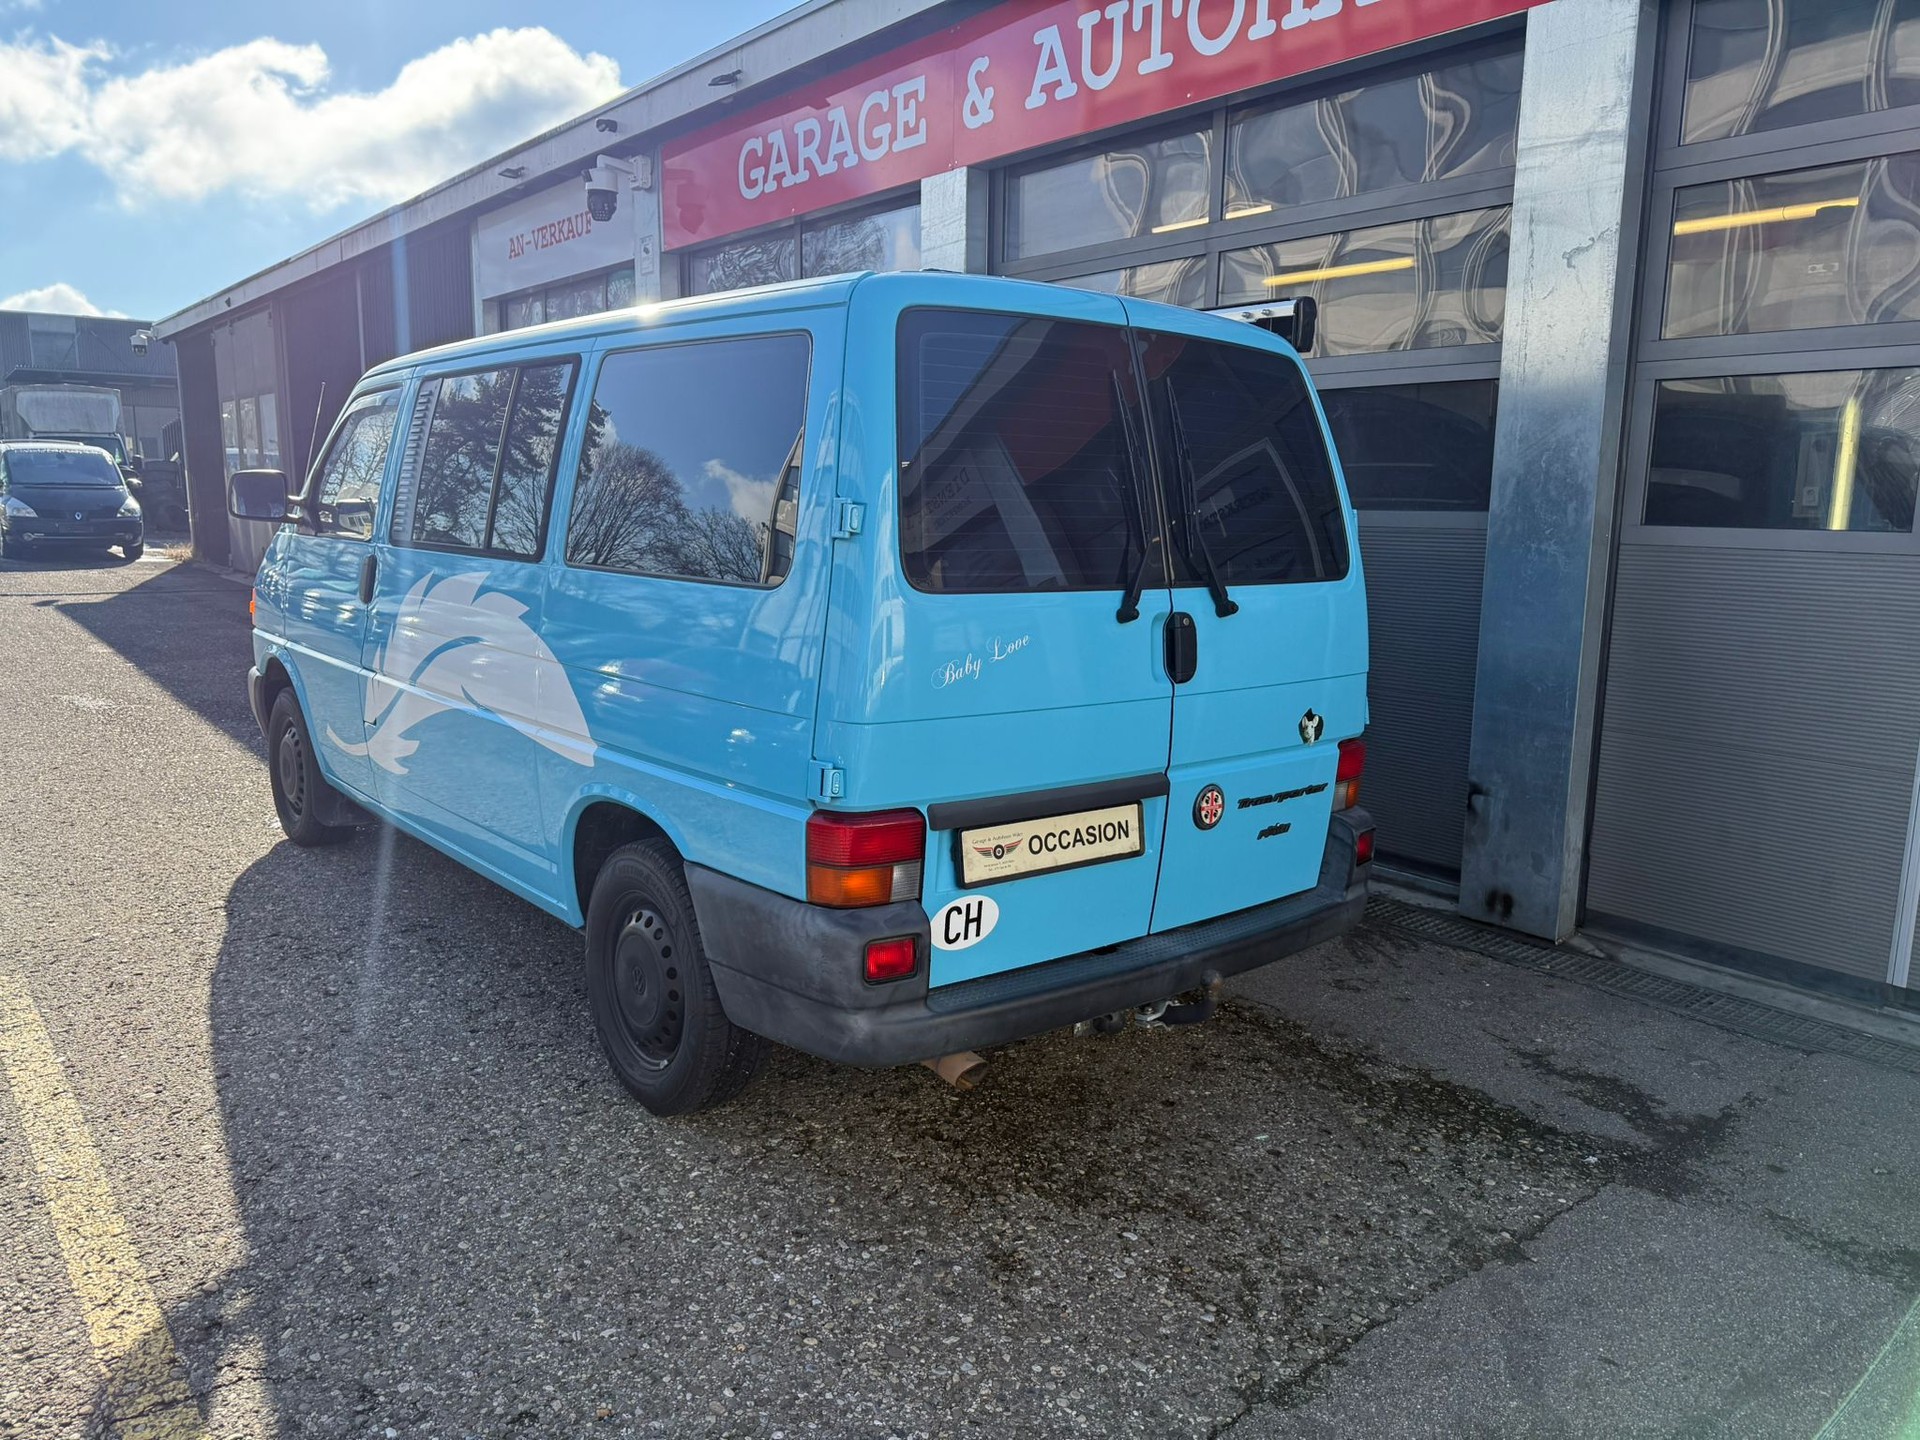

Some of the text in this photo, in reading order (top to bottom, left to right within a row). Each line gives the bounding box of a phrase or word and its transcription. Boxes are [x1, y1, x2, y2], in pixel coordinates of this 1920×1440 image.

[738, 0, 1384, 200] GARAGE & AUTO
[508, 209, 593, 260] AN-VERKAUF
[931, 634, 1030, 689] Baby Love
[1028, 819, 1130, 855] OCCASION
[944, 900, 983, 945] CH
